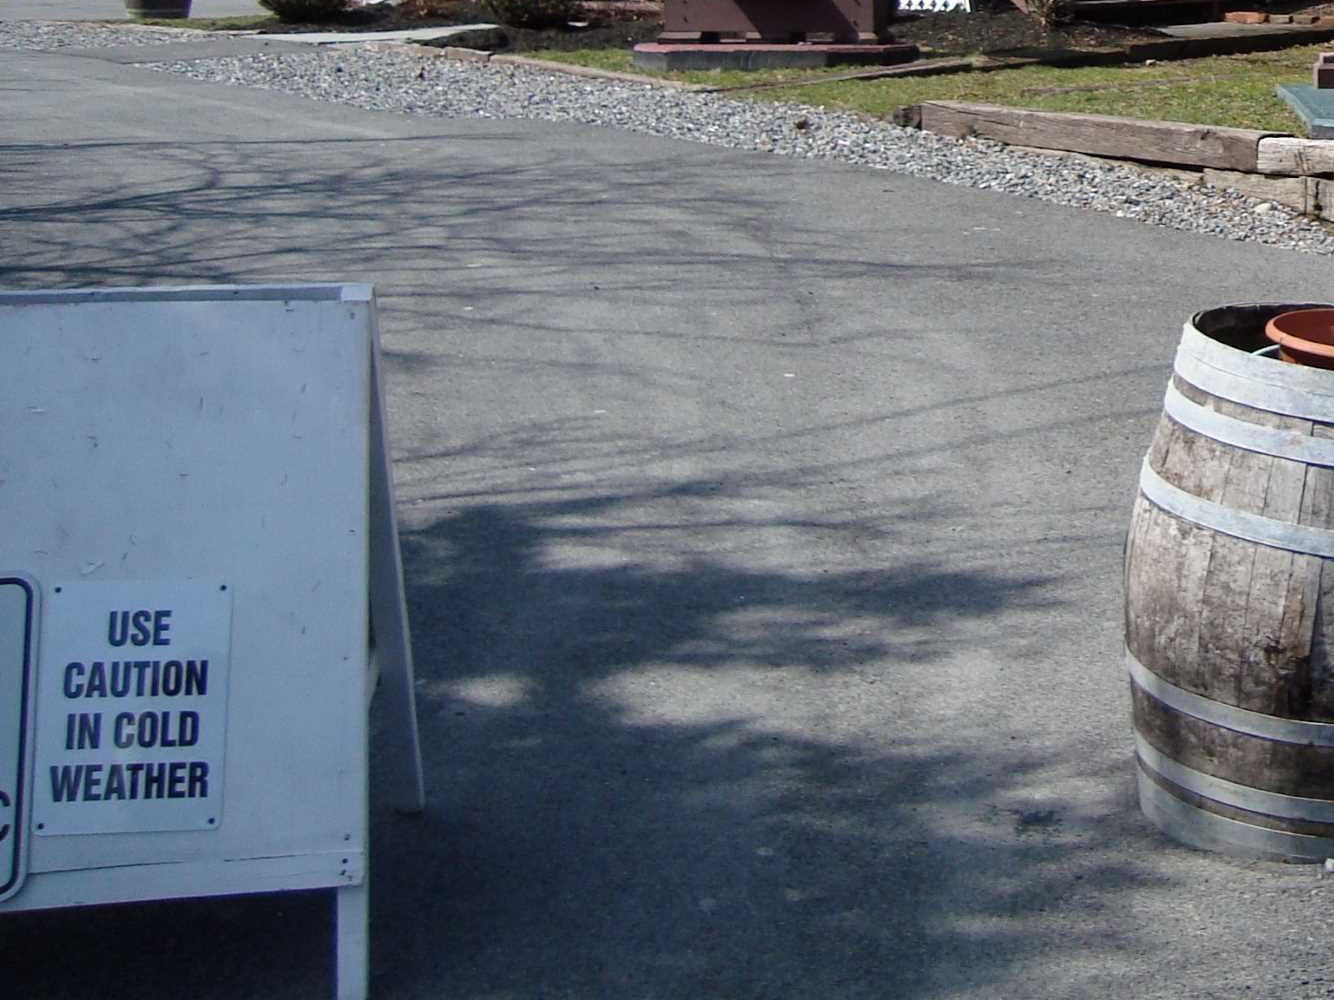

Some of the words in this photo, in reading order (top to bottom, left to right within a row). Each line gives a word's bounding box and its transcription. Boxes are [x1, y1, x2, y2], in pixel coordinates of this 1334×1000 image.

[108, 610, 172, 647] USE
[63, 660, 208, 699] CAUTION
[65, 713, 102, 750] IN
[113, 711, 199, 748] COLD
[50, 762, 209, 802] WEATHER
